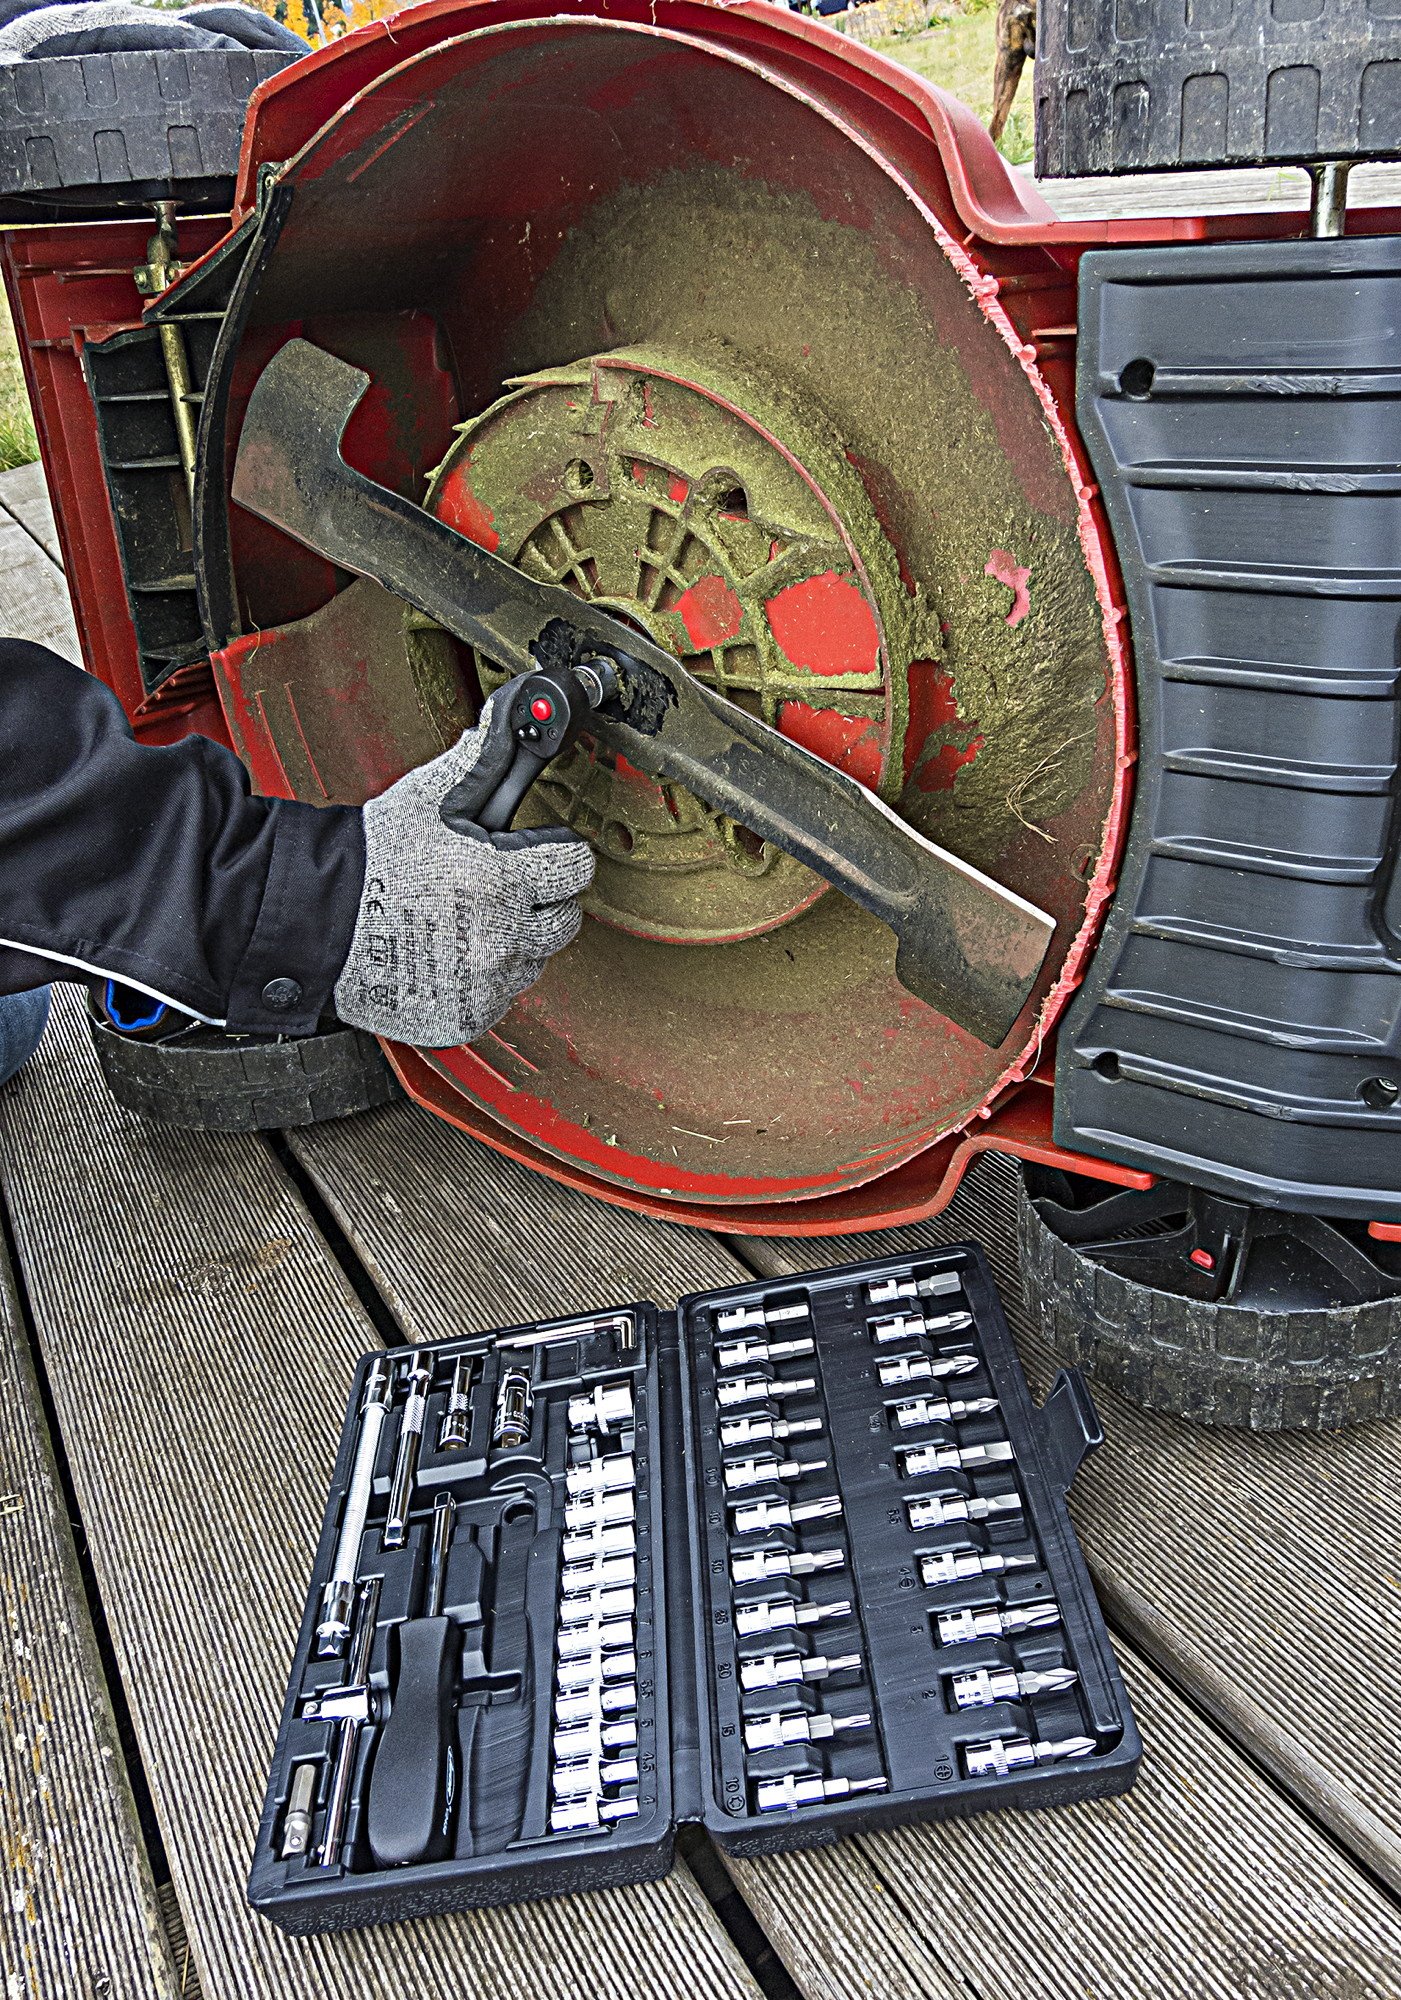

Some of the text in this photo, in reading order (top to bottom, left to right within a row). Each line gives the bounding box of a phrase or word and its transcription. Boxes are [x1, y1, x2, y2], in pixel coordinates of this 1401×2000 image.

[367, 878, 385, 916] CE
[711, 1559, 724, 1574] 30
[640, 1618, 652, 1626] 7
[714, 1610, 728, 1625] 25
[910, 1625, 924, 1634] 3
[640, 1650, 652, 1659] 6
[718, 1662, 732, 1680] 20
[640, 1679, 654, 1700] 5.5
[922, 1688, 936, 1700] 2
[640, 1718, 654, 1728] 5
[722, 1724, 736, 1738] 15
[642, 1752, 655, 1773] 4.5
[935, 1754, 949, 1762] 1
[726, 1778, 740, 1793] 10
[642, 1796, 656, 1805] 4
